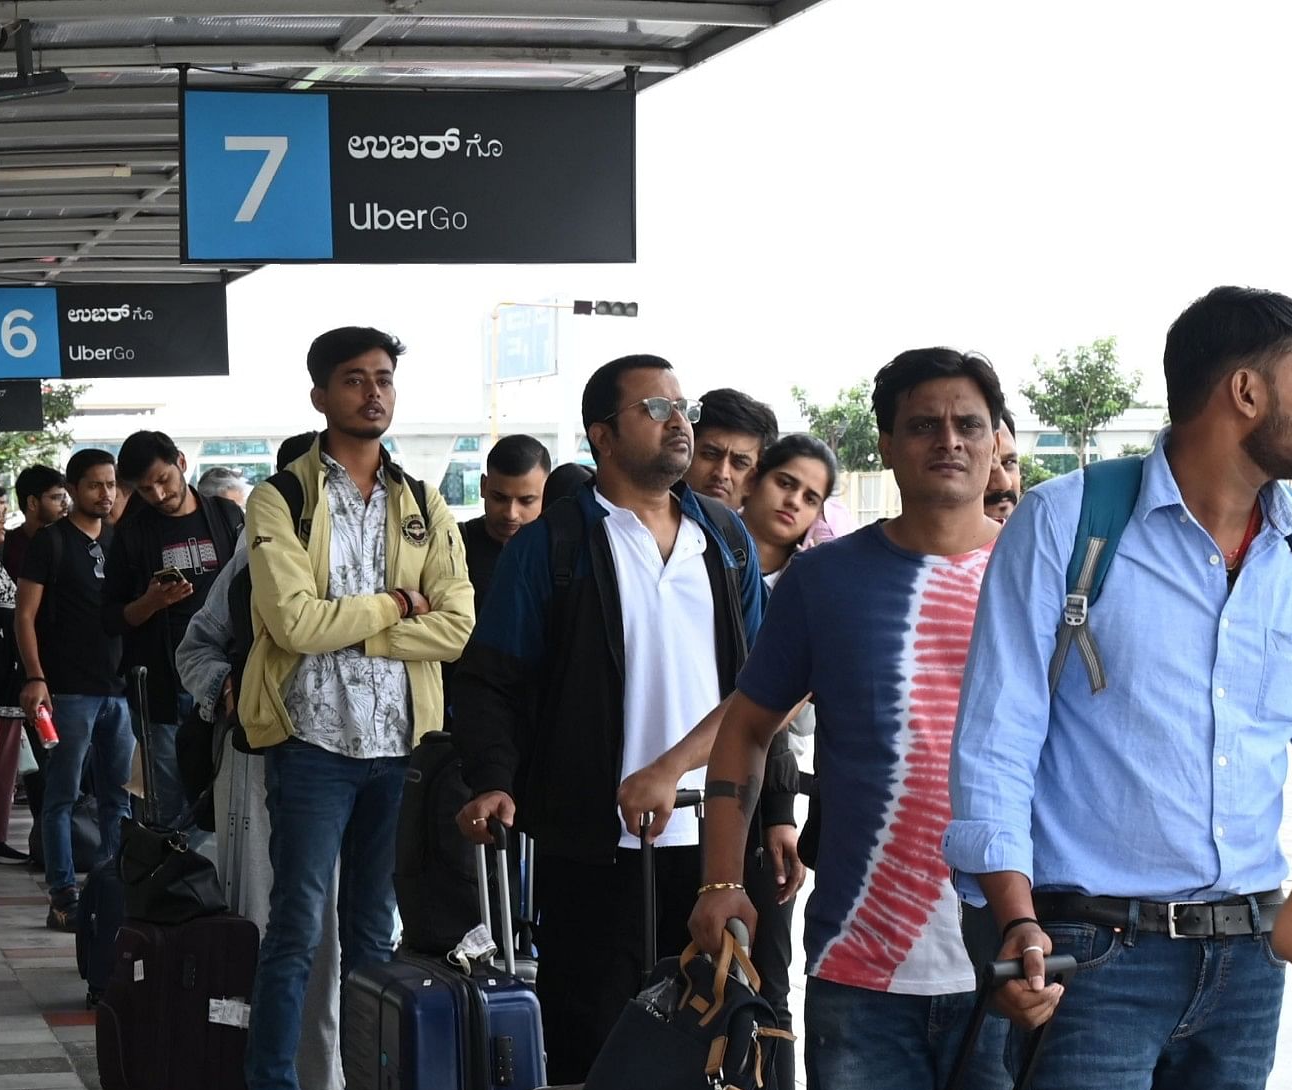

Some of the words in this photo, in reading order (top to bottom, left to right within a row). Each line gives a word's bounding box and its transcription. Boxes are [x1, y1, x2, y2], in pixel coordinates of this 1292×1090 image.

[347, 127, 461, 159] ಉಬರ್
[223, 135, 289, 223] 7
[0, 308, 38, 358] 6
[67, 303, 131, 323] ಉಬರ್
